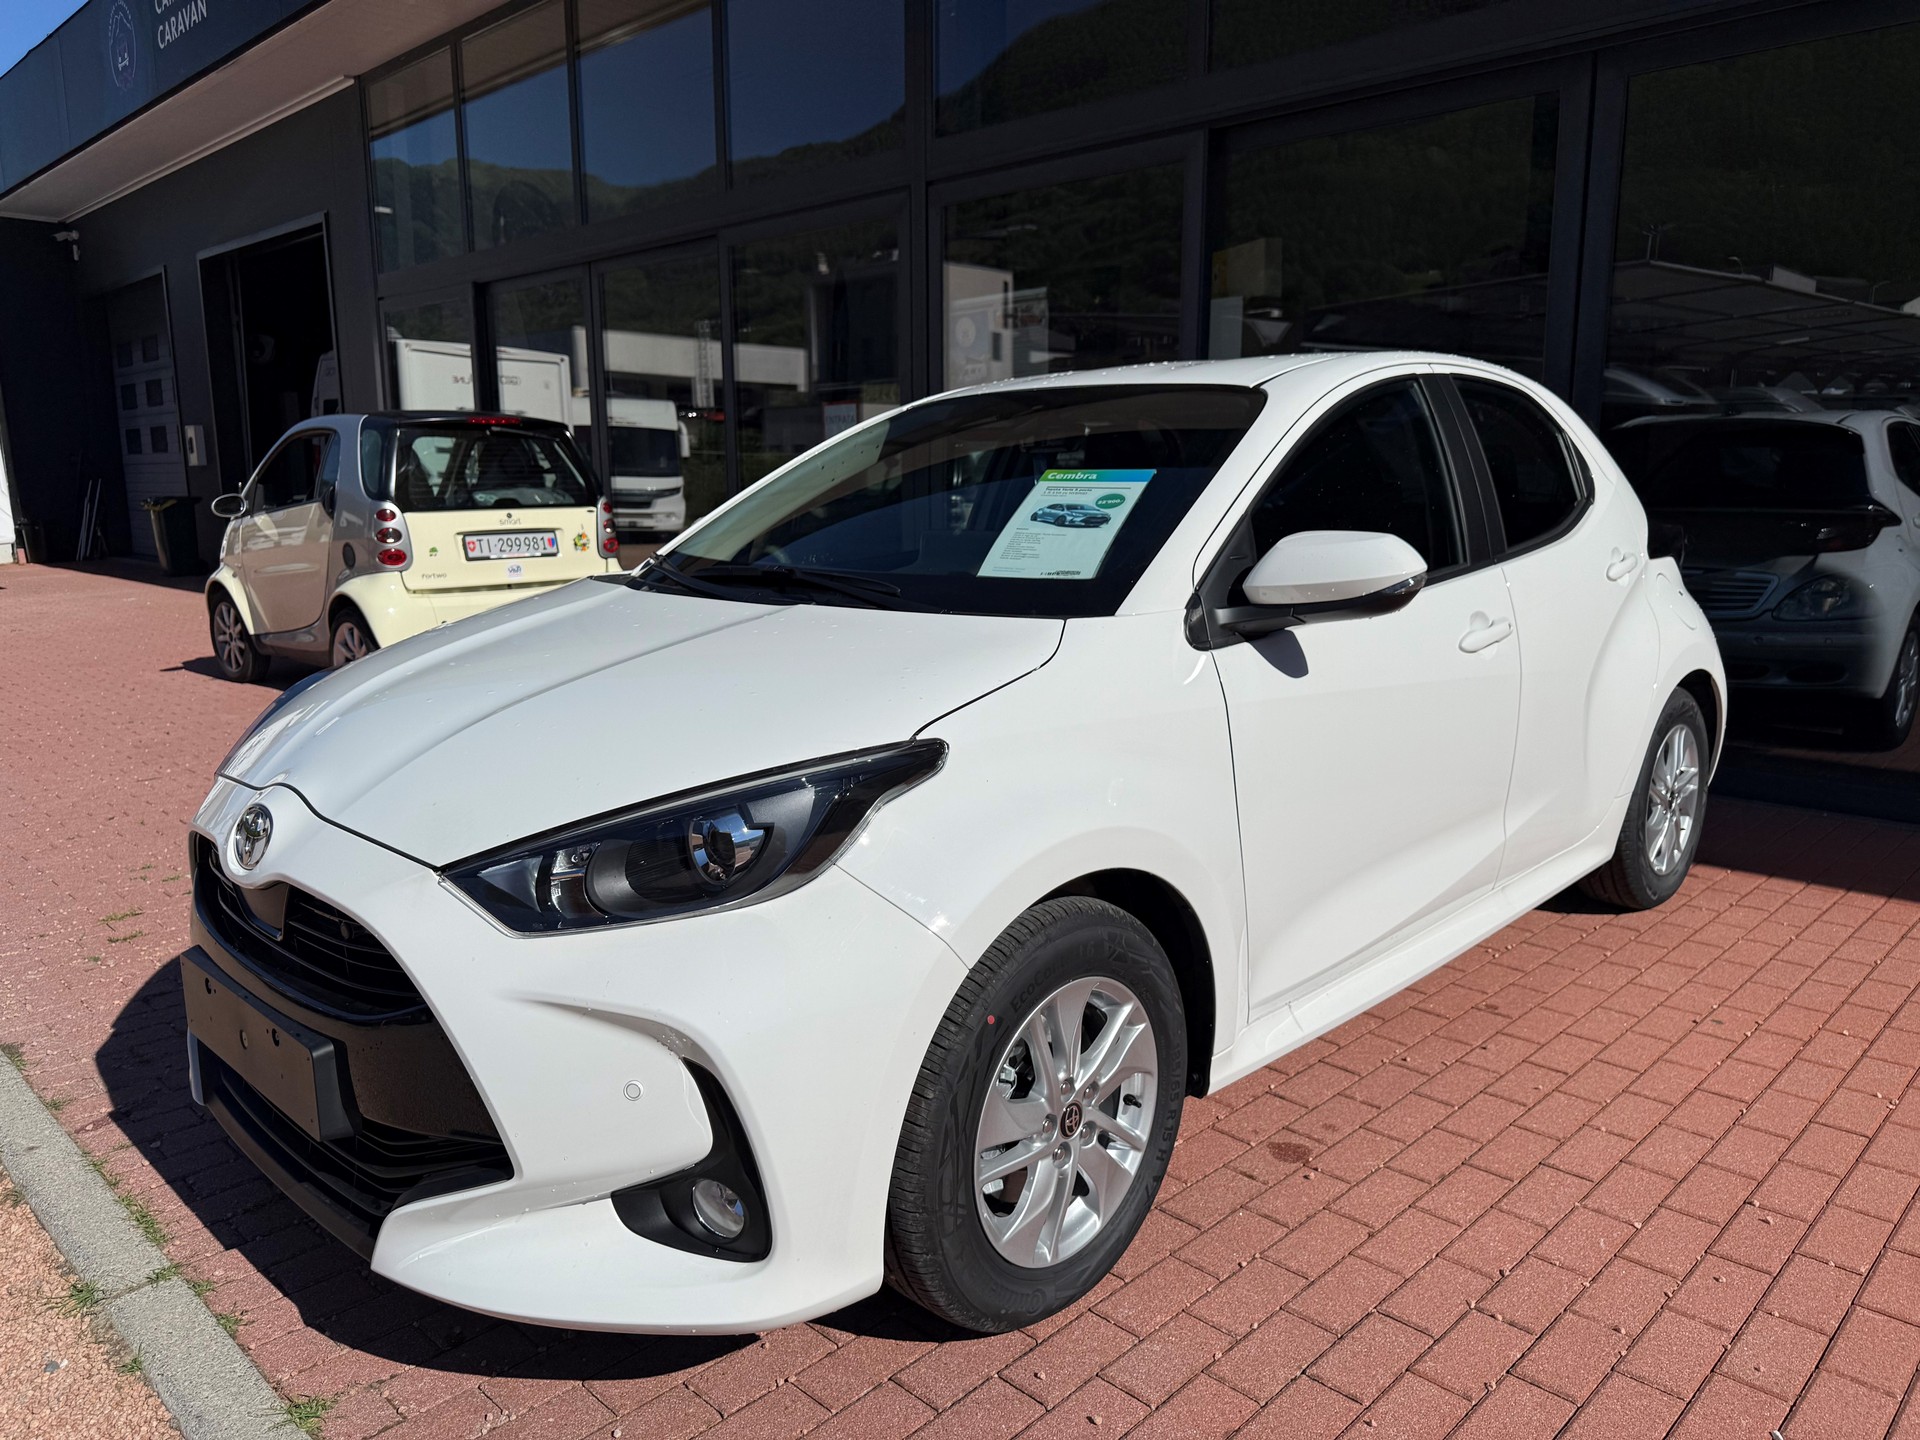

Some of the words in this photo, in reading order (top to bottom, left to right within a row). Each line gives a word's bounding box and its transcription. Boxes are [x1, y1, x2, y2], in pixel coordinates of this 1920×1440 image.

[157, 0, 207, 49] CARAVAN
[1047, 472, 1098, 480] Cembra
[499, 518, 521, 526] smart
